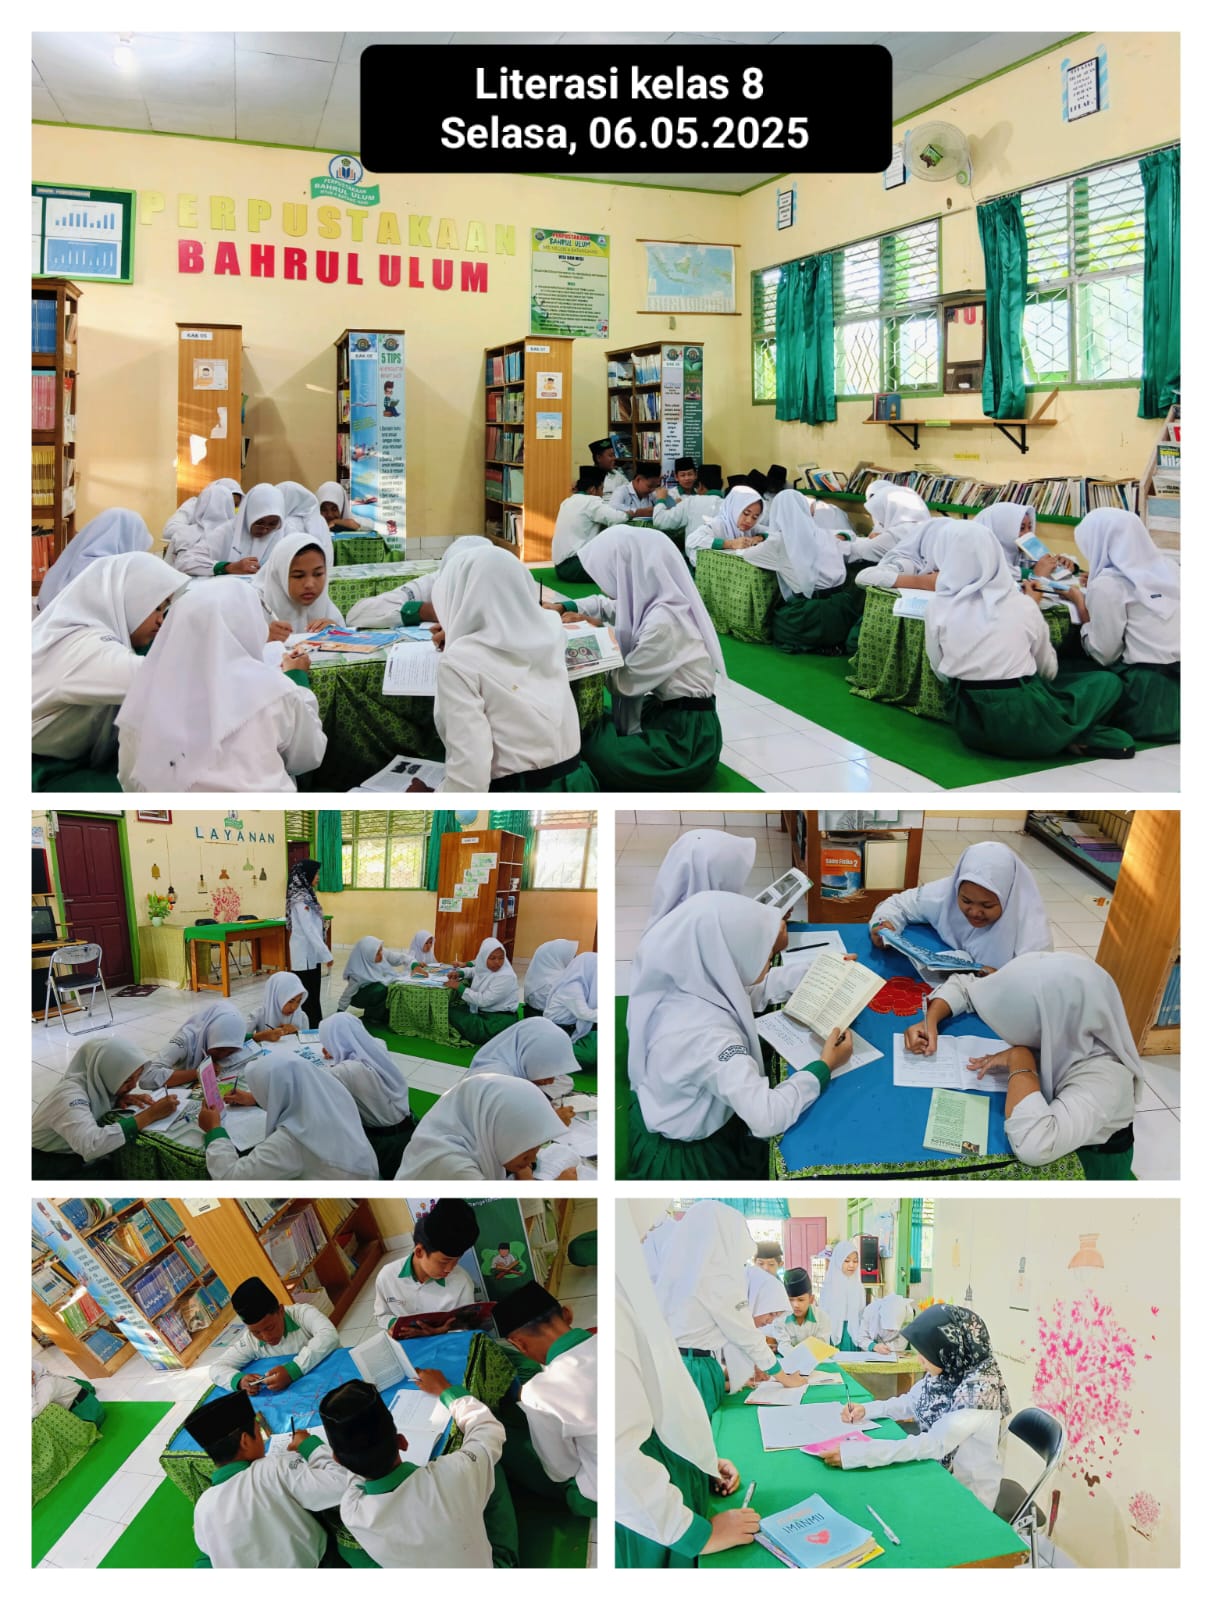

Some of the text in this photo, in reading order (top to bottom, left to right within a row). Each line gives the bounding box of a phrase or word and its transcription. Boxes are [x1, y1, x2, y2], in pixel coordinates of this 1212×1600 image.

[314, 183, 375, 201] BAHRUL ULUM
[140, 190, 517, 256] PERPUSTAKAAN
[574, 240, 591, 248] ULUM
[178, 239, 488, 293] BAHRUL ULUM
[381, 352, 402, 364] 5 TIPS
[195, 826, 275, 844] LAYANAN
[782, 1512, 825, 1534] IMANMU
